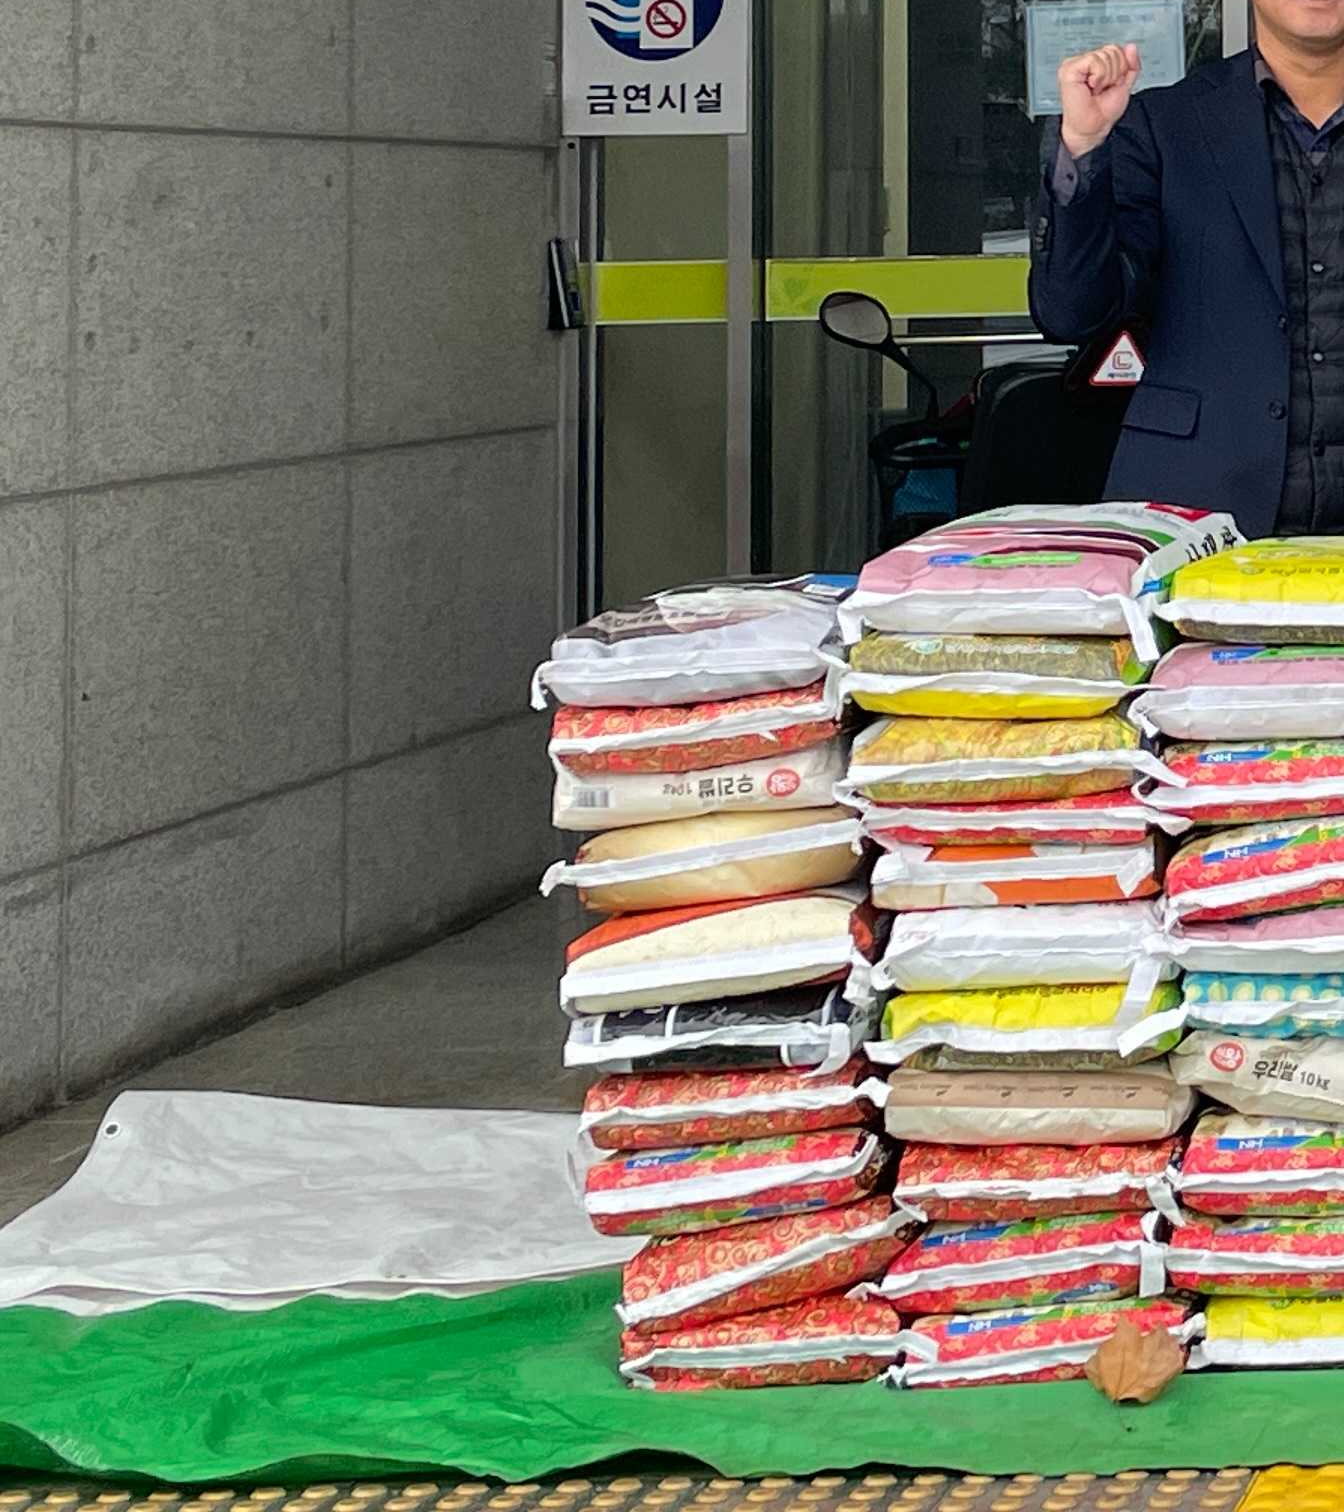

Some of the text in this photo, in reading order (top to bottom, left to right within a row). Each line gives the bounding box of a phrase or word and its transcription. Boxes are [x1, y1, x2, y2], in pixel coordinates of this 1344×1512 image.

[586, 82, 723, 116] 금연시설
[1251, 1058, 1298, 1082] 우리쌀
[1237, 1138, 1265, 1150] NH
